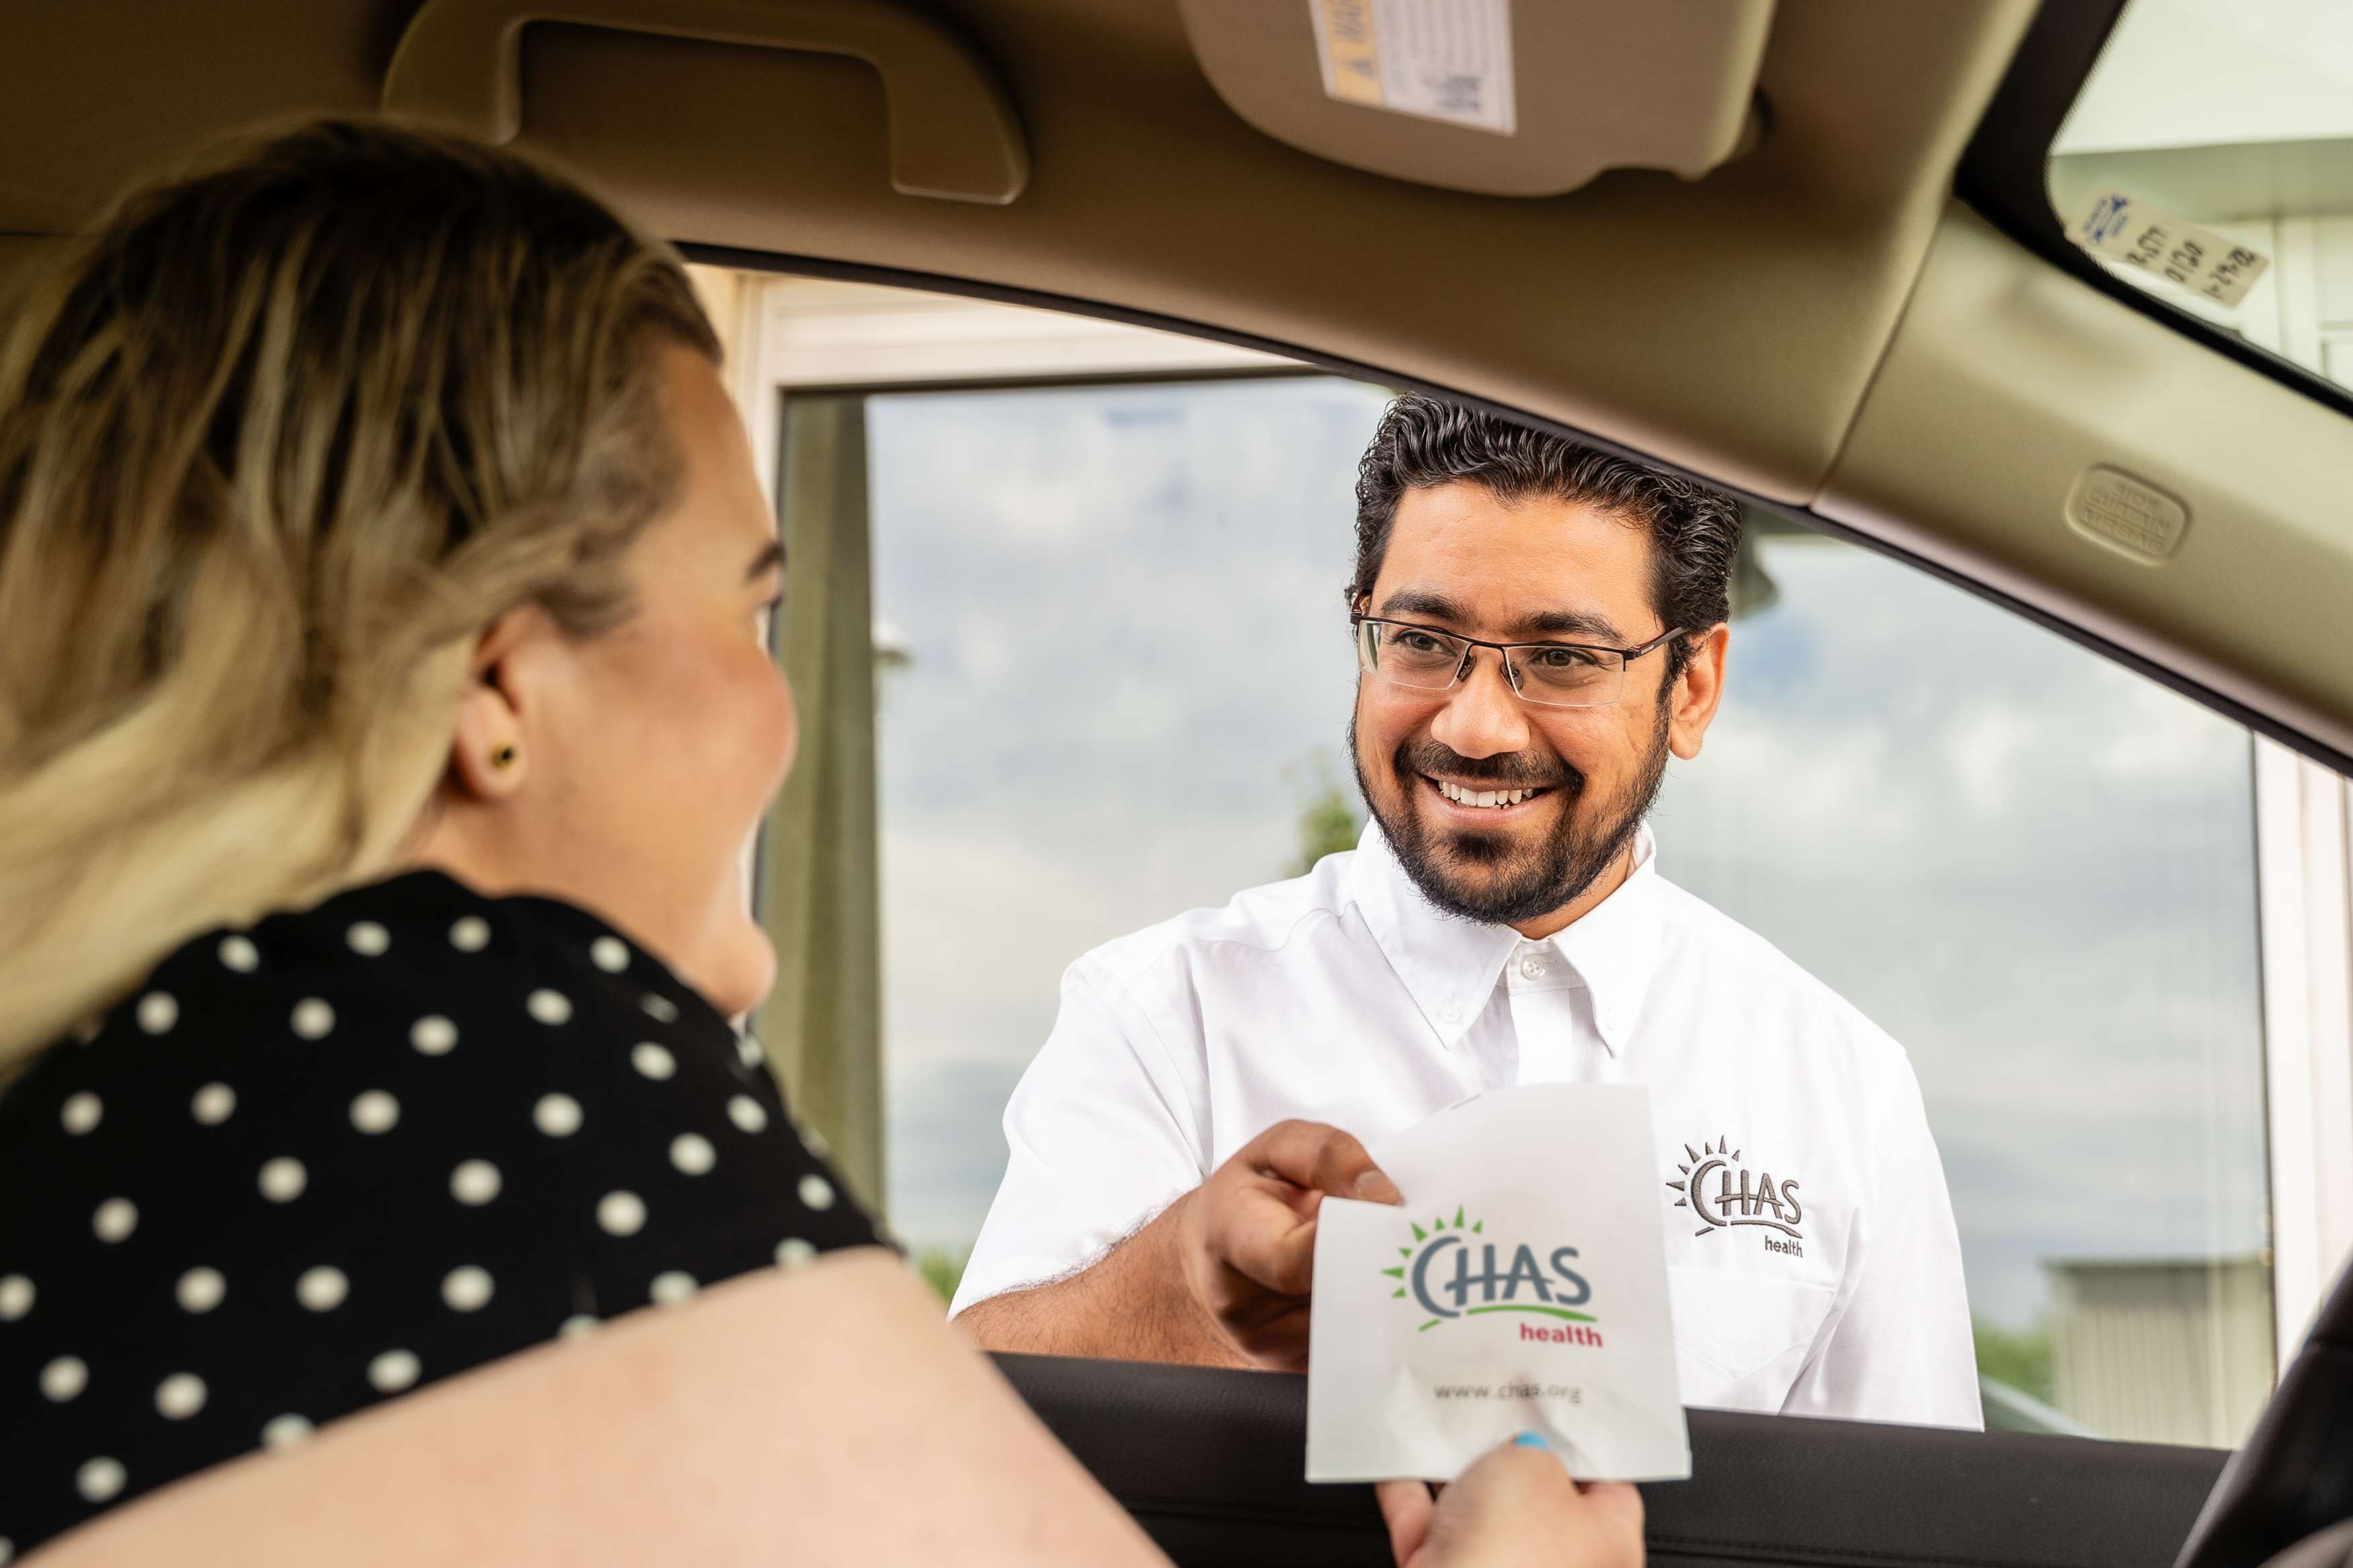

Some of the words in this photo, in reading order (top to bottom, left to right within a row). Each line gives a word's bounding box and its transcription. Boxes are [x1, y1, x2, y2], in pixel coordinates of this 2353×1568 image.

[1691, 1160, 1802, 1227] CHAS
[1765, 1235, 1803, 1258] health
[1411, 1236, 1591, 1318] CHAS
[1519, 1323, 1603, 1348] health
[1433, 1380, 1582, 1404] www.chas.org
